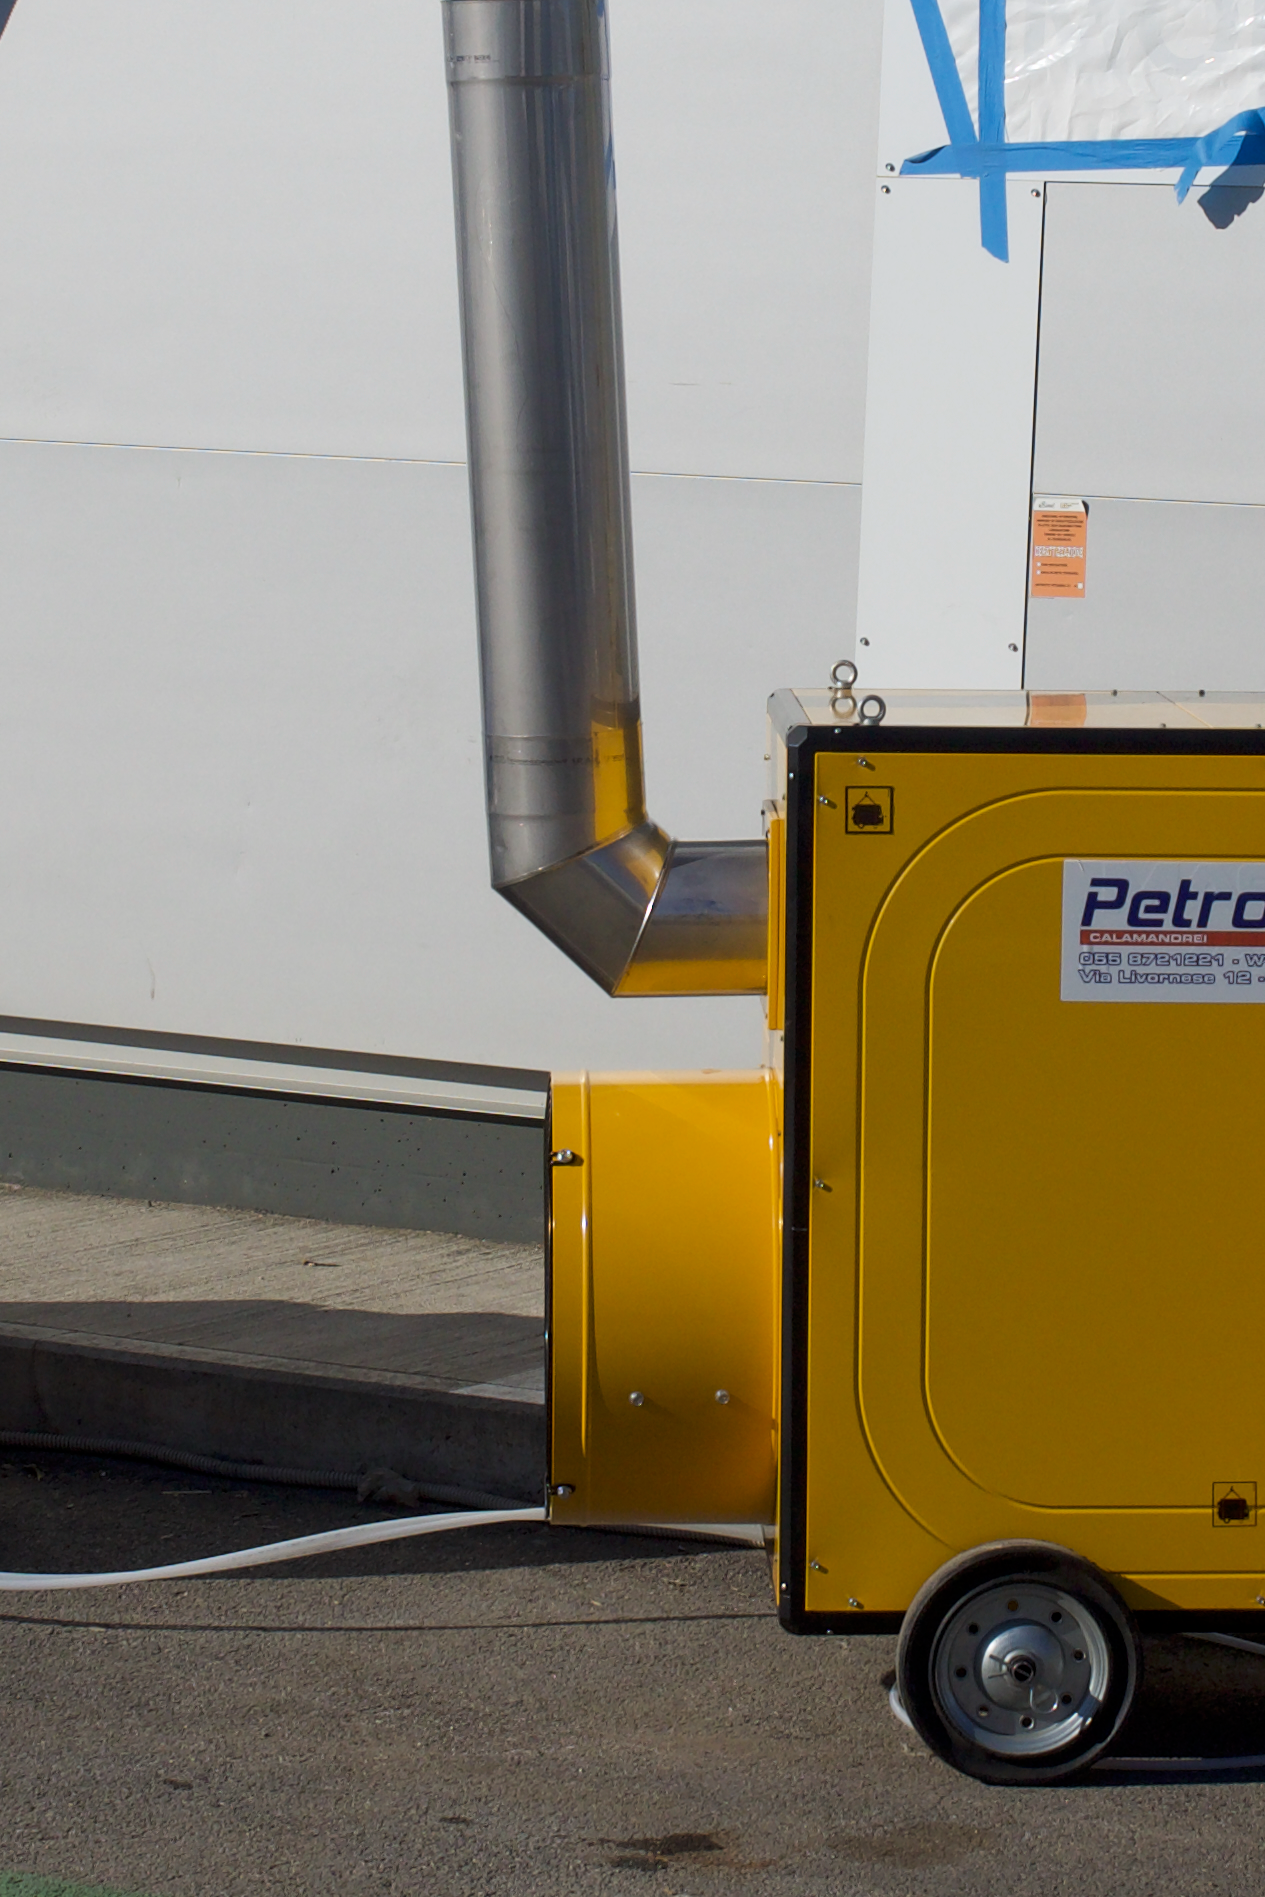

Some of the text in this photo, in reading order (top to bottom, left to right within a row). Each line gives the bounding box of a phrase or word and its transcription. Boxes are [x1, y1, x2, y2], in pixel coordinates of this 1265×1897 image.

[1089, 932, 1208, 944] CALAMANDREI
[1079, 952, 1122, 966] 055
[1127, 952, 1224, 967] 8721221
[1078, 969, 1112, 983] Via
[1118, 970, 1216, 984] Livornese
[1223, 971, 1252, 985] 12
